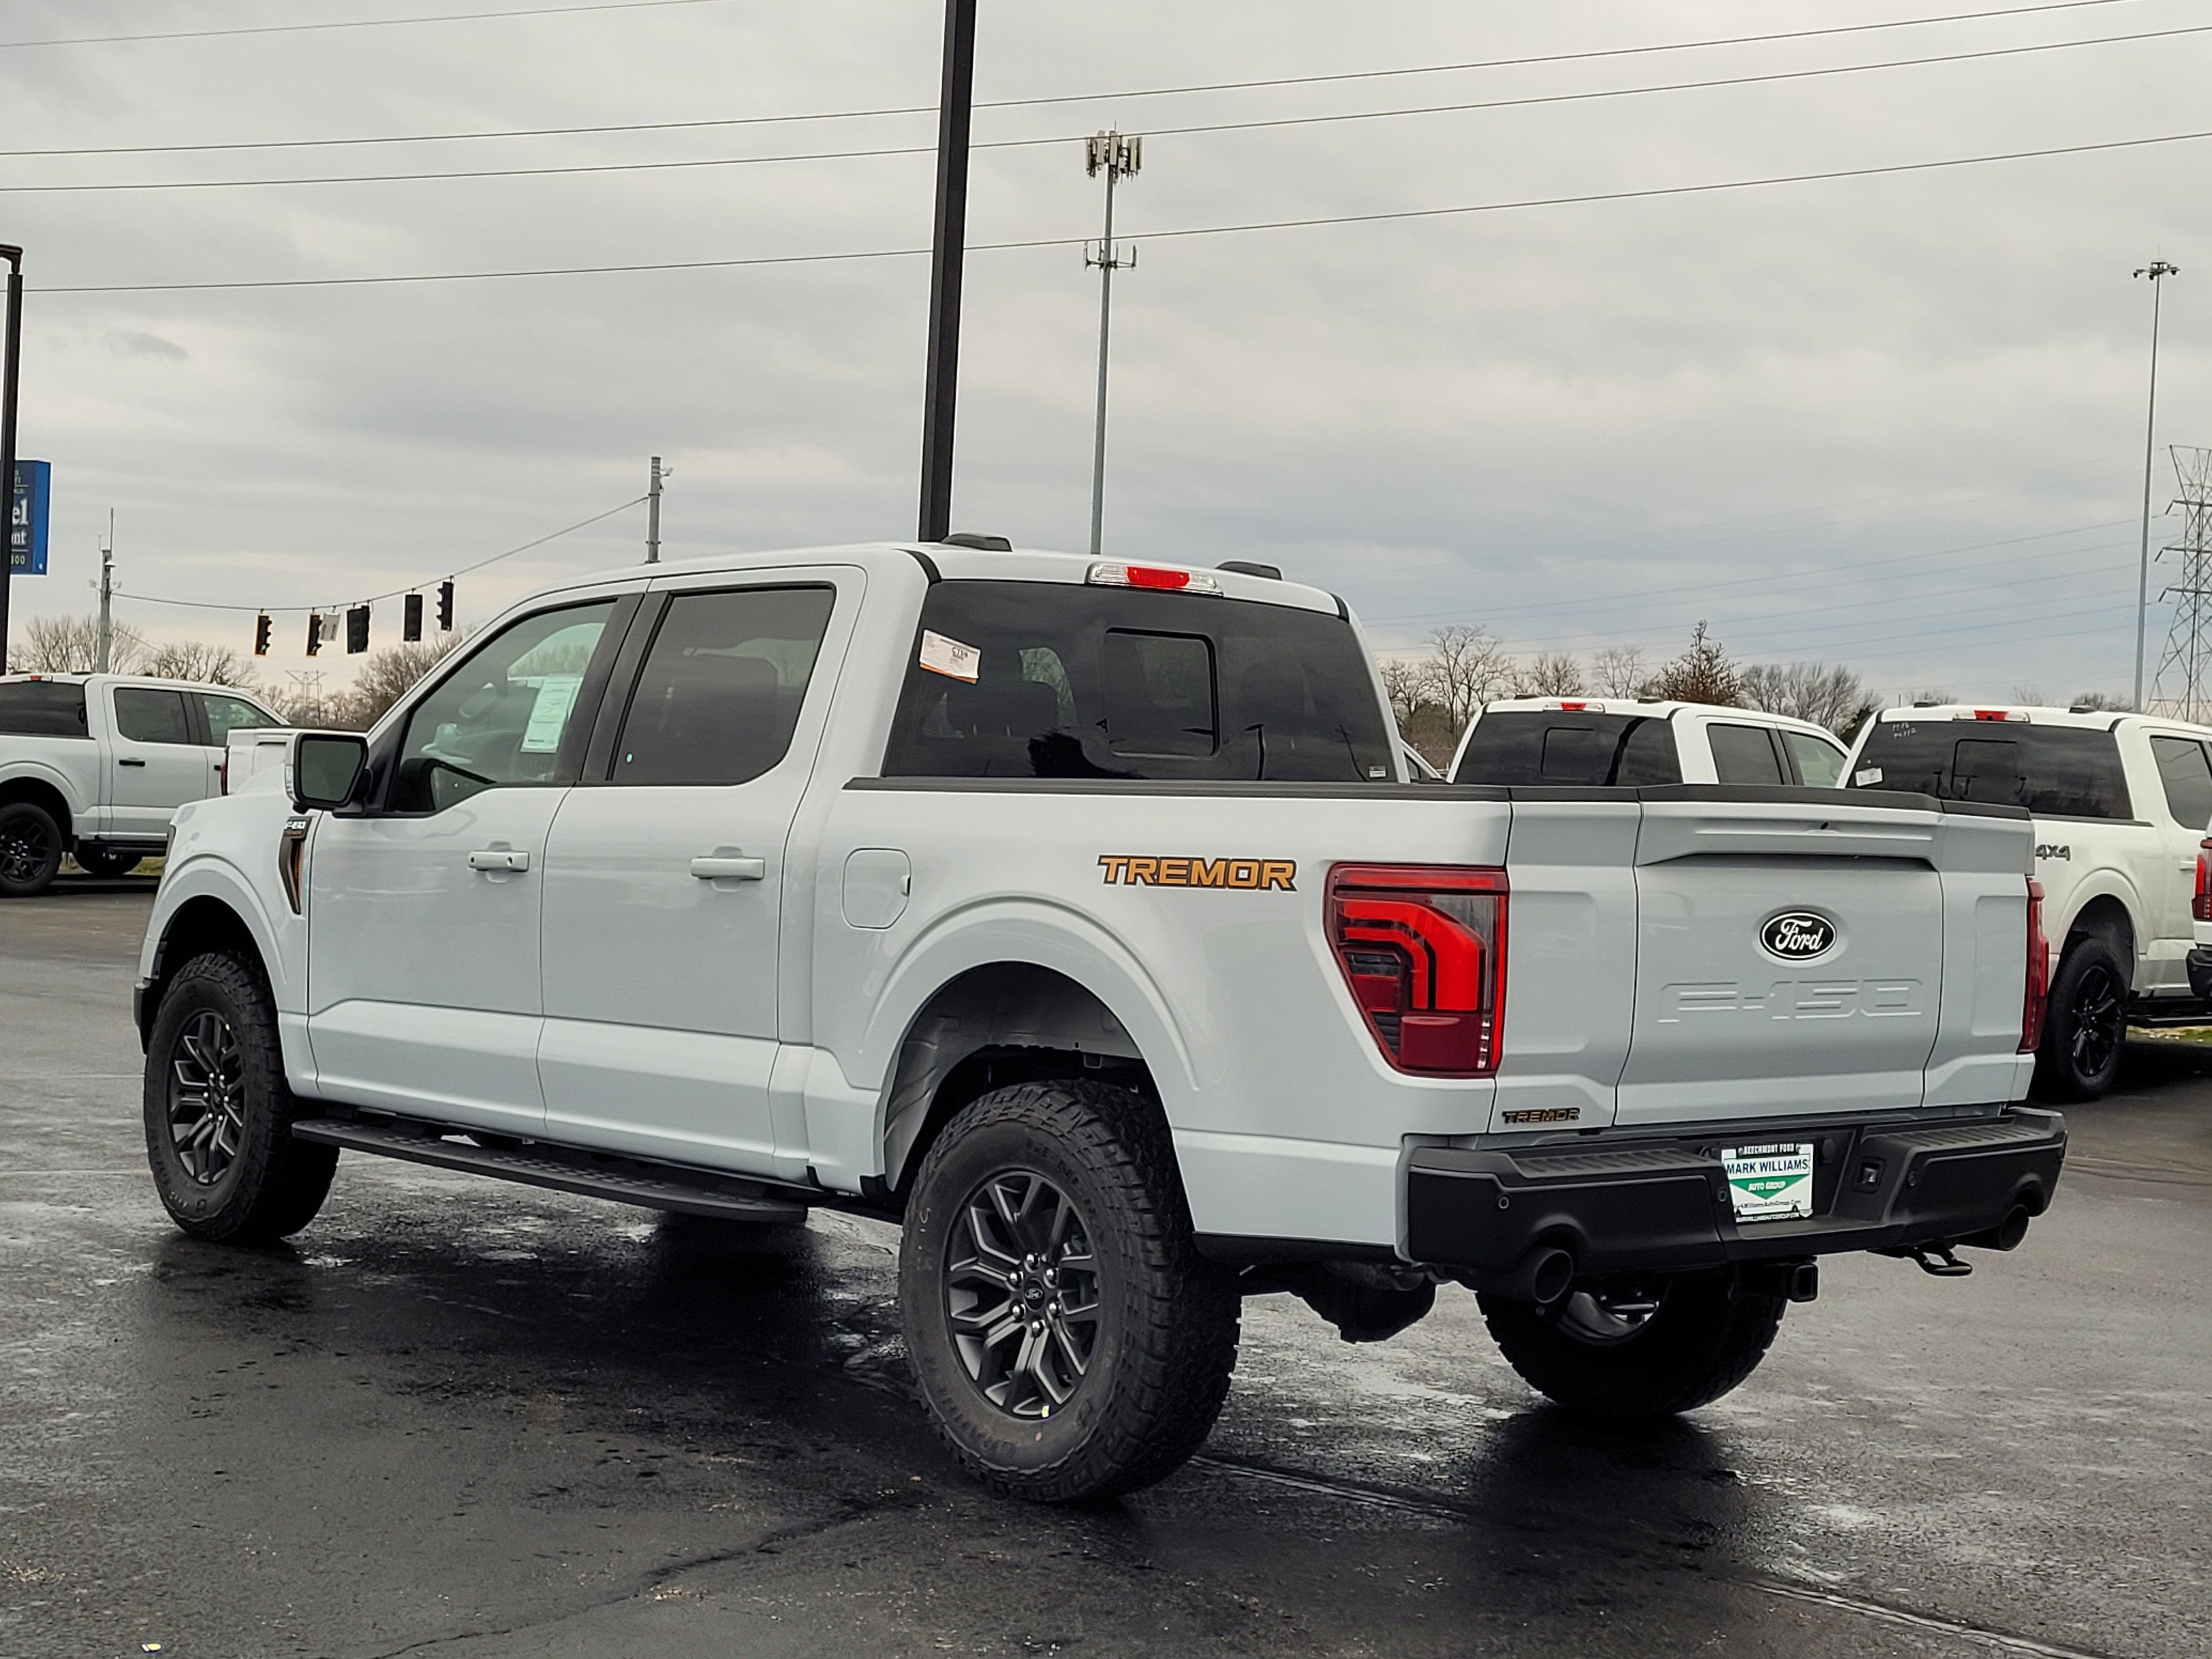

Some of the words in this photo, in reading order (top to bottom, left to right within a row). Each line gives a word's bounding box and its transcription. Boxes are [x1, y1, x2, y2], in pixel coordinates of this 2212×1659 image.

[1097, 855, 1297, 891] TREMOR
[1775, 918, 1824, 950] Ford
[1657, 979, 1923, 1023] F-150
[1502, 1107, 1581, 1124] TREMOR
[1727, 1162, 1757, 1175] MARK
[1759, 1159, 1809, 1172] WILLIAMS
[1748, 1182, 1764, 1191] AUTO
[1765, 1181, 1786, 1190] GROUP
